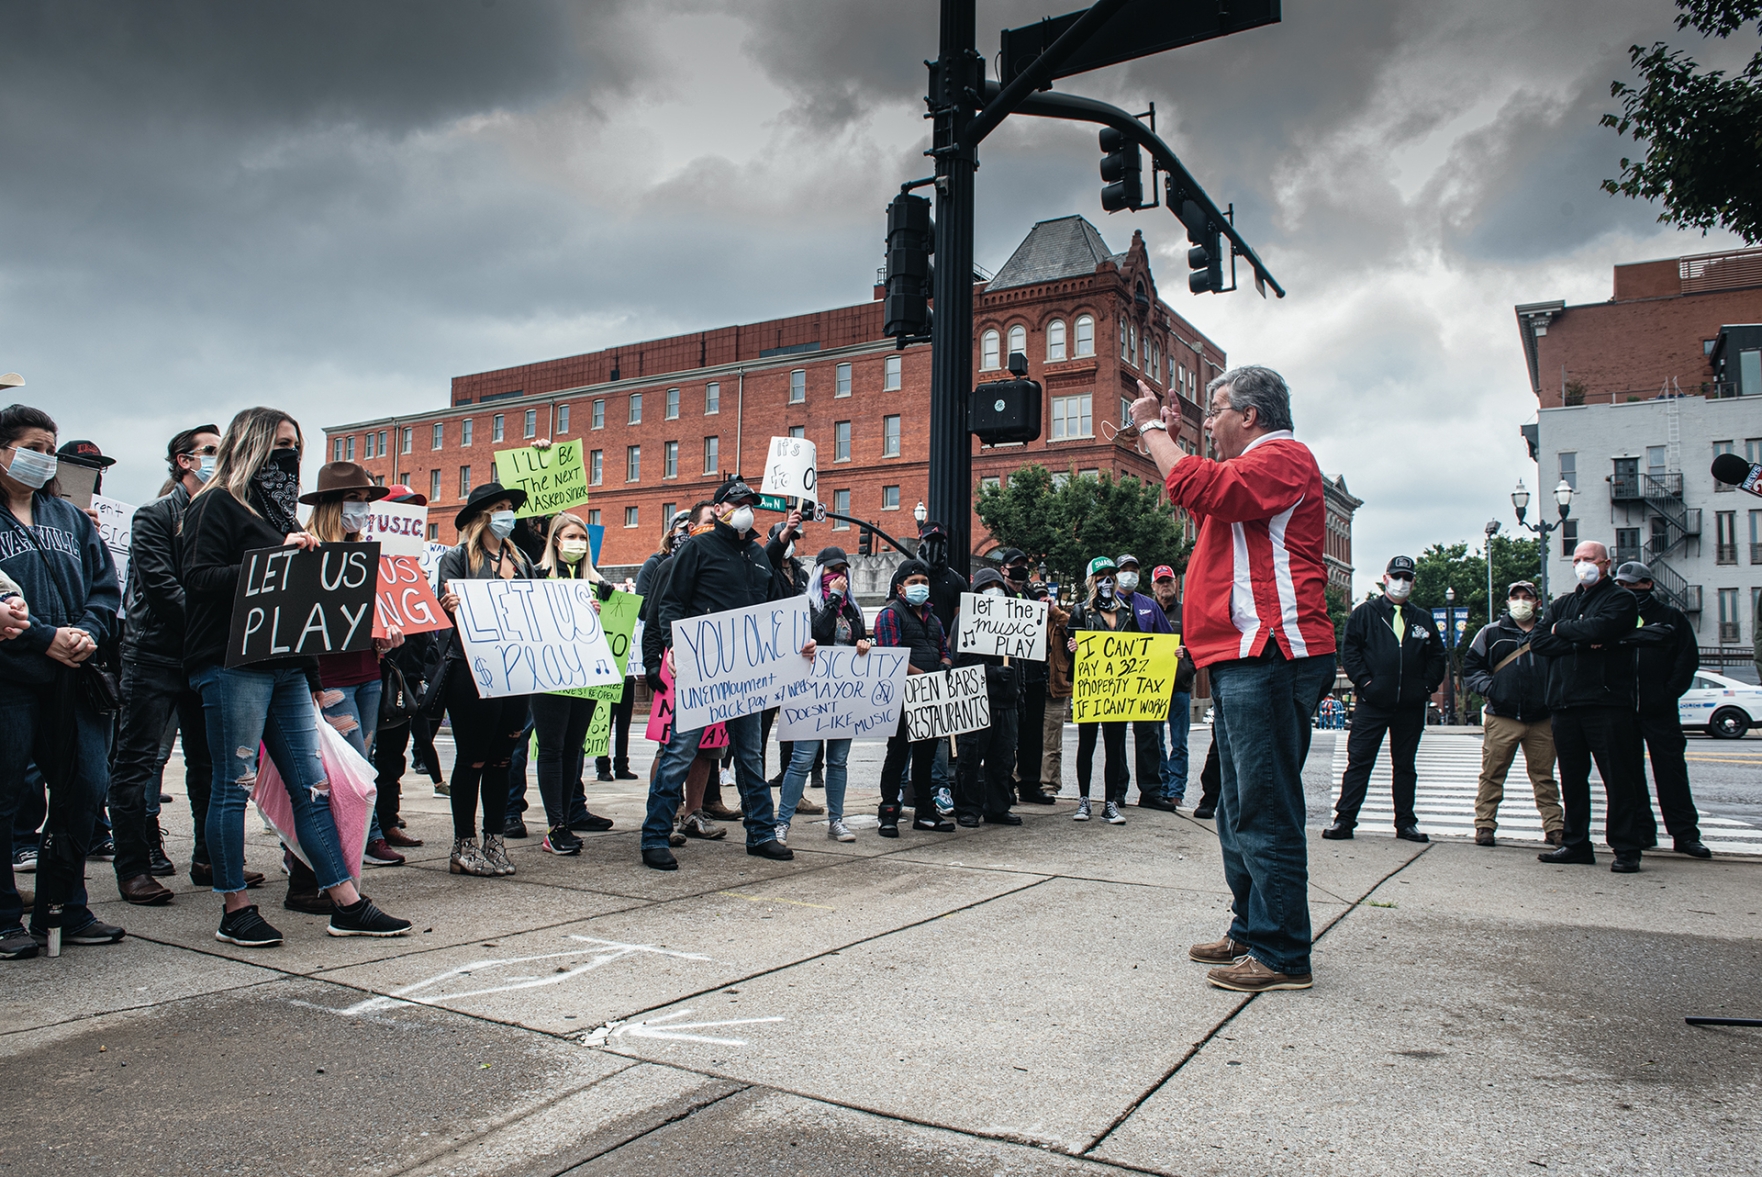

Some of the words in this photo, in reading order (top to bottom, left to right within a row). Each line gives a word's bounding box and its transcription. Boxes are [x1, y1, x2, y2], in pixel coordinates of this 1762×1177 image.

[512, 452, 548, 473] I'LL
[1743, 466, 1761, 489] NEWS
[760, 497, 772, 508] Ave
[774, 499, 781, 509] N
[245, 549, 300, 597] LET
[321, 551, 367, 591] US
[379, 557, 419, 584] US
[453, 581, 543, 643] LET
[543, 581, 599, 644] US
[973, 596, 994, 616] let
[1005, 599, 1033, 618] the
[242, 602, 368, 655] PLAY
[972, 618, 1036, 636] music
[680, 618, 735, 682] YOU
[744, 610, 786, 667] OWE
[995, 636, 1035, 658] PLAY
[1079, 635, 1096, 660] I
[1104, 636, 1154, 658] CAN'T
[810, 650, 845, 679] SIC
[851, 652, 904, 678] CITY
[1078, 660, 1099, 677] PAY
[1105, 662, 1113, 675] A
[1117, 658, 1150, 677] 32%
[905, 675, 940, 703] OPEN
[947, 668, 979, 698] BARS
[1077, 678, 1130, 697] PROPERTY
[1136, 677, 1166, 694] TAX
[709, 698, 746, 723] back
[748, 694, 768, 714] pay
[785, 701, 838, 725] DOESN'T
[905, 695, 990, 739] RESTAURANTS
[1076, 699, 1089, 719] IF
[1093, 699, 1102, 716] I
[1103, 698, 1137, 715] CAN'T
[1140, 698, 1169, 719] WORK
[816, 712, 855, 732] LIKE
[854, 709, 895, 735] MUSIC
